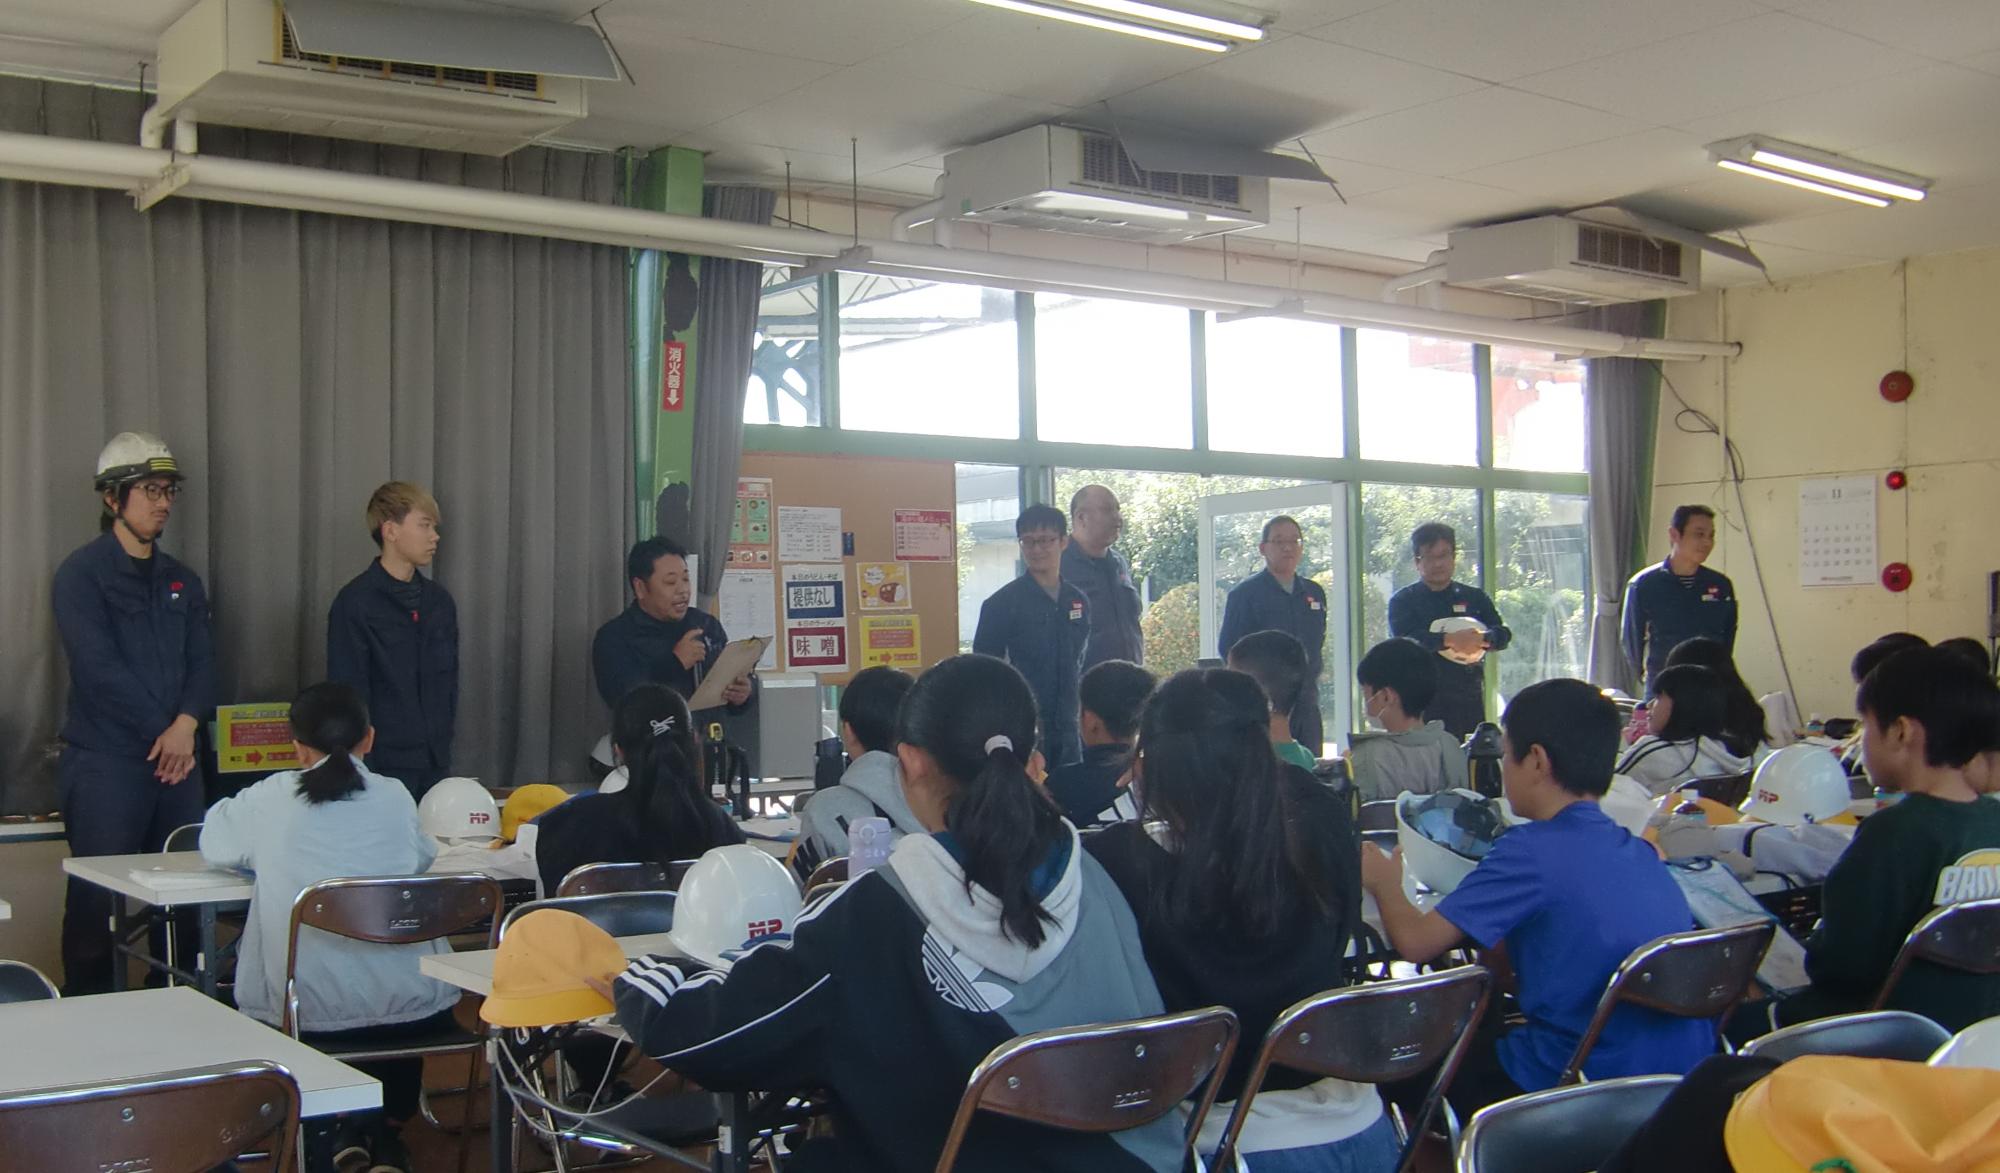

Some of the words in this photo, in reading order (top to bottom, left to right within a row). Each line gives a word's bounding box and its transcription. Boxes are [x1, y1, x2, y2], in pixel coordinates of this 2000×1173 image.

[668, 347, 682, 389] 消火器
[793, 587, 831, 607] 提供なし
[469, 812, 490, 824] MP
[748, 919, 782, 939] MP
